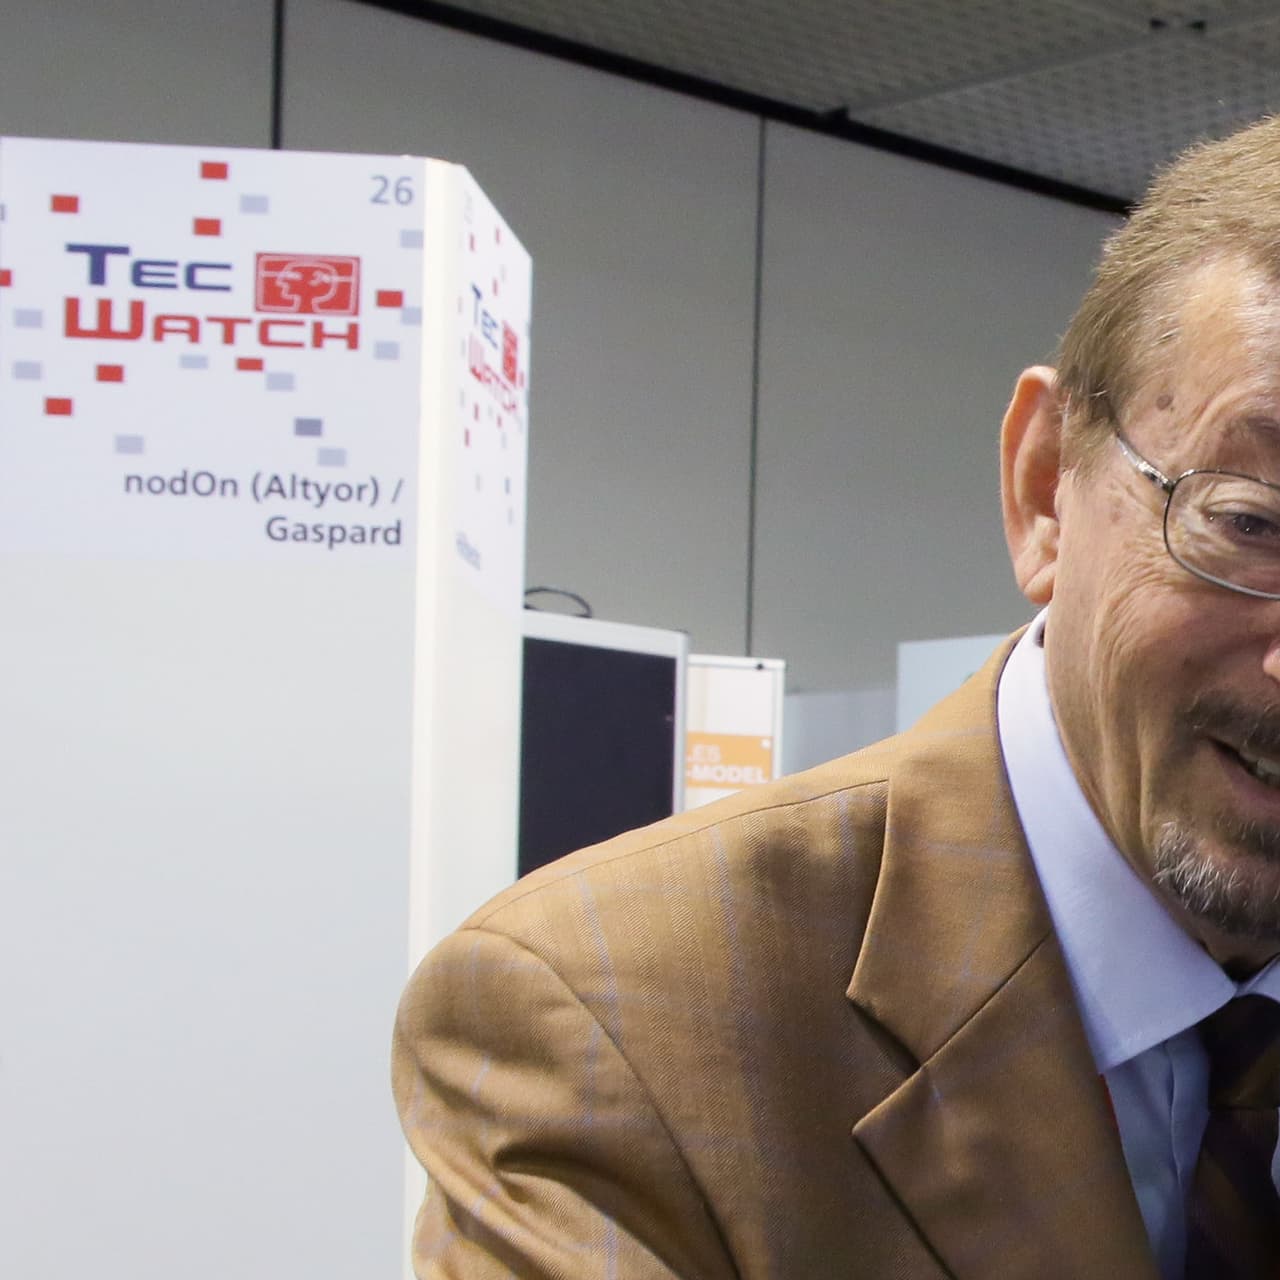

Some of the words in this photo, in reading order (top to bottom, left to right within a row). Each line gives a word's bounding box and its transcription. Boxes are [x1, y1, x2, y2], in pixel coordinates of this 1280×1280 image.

[369, 174, 414, 206] 26
[123, 471, 239, 498] nodOn
[251, 472, 381, 508] (Altyor)
[390, 478, 404, 503] /
[265, 516, 403, 550] Gaspard
